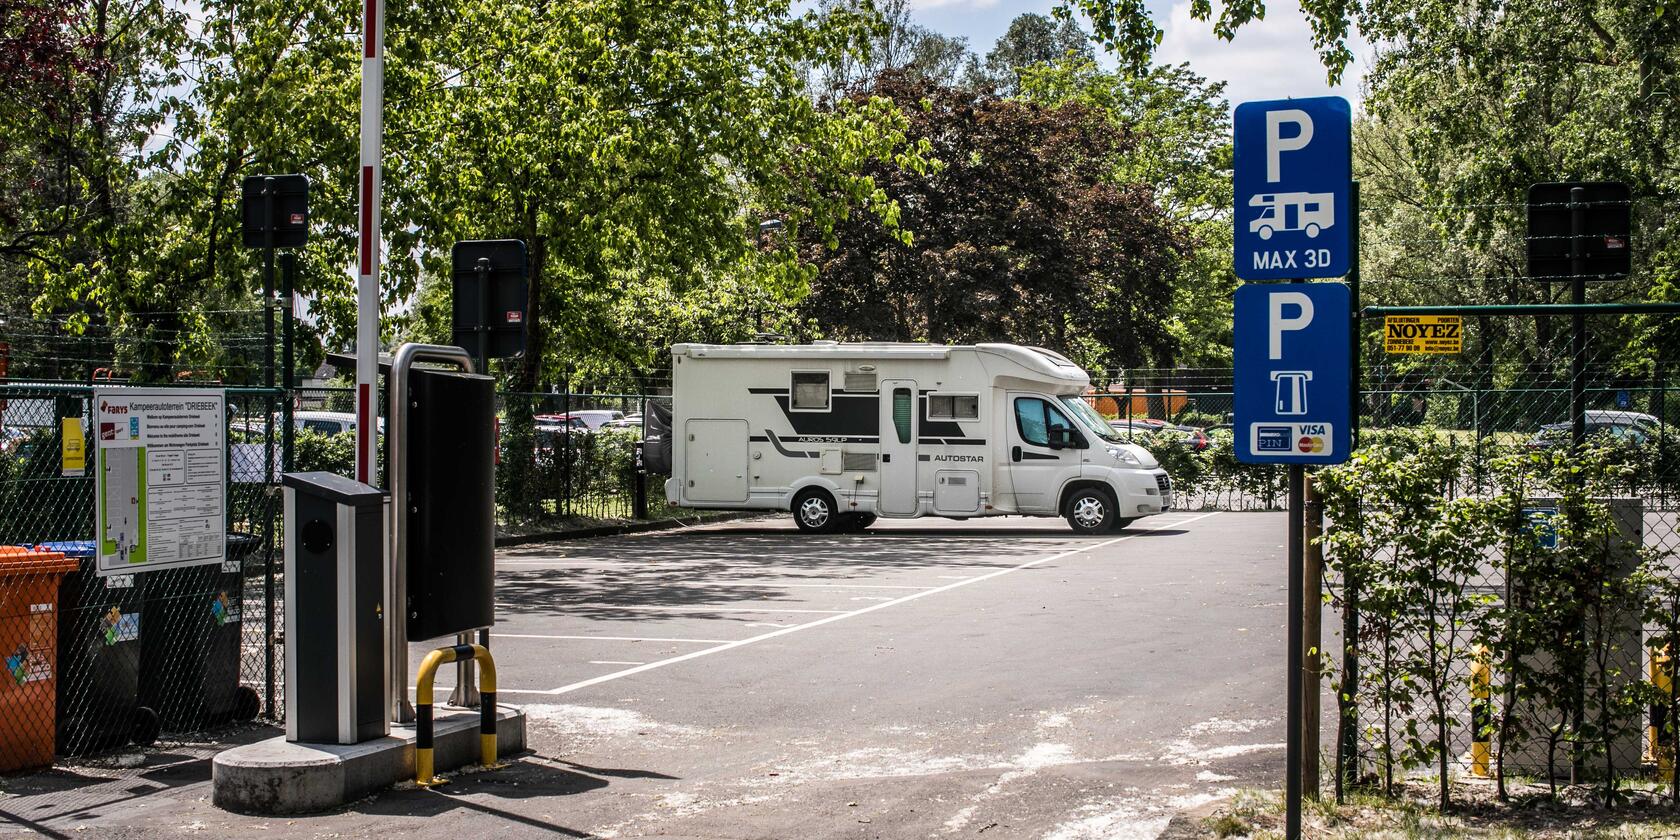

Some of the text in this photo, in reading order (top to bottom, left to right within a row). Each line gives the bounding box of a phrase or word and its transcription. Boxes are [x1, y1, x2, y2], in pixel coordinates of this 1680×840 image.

[1266, 109, 1314, 183] P
[1253, 248, 1331, 270] MAX 3D
[1269, 292, 1315, 360] P
[1387, 324, 1459, 338] NOYEZ
[130, 402, 184, 412] Kampeerautoterrein
[1259, 425, 1326, 447] PIN VISA
[934, 454, 984, 462] AUTOSTAR
